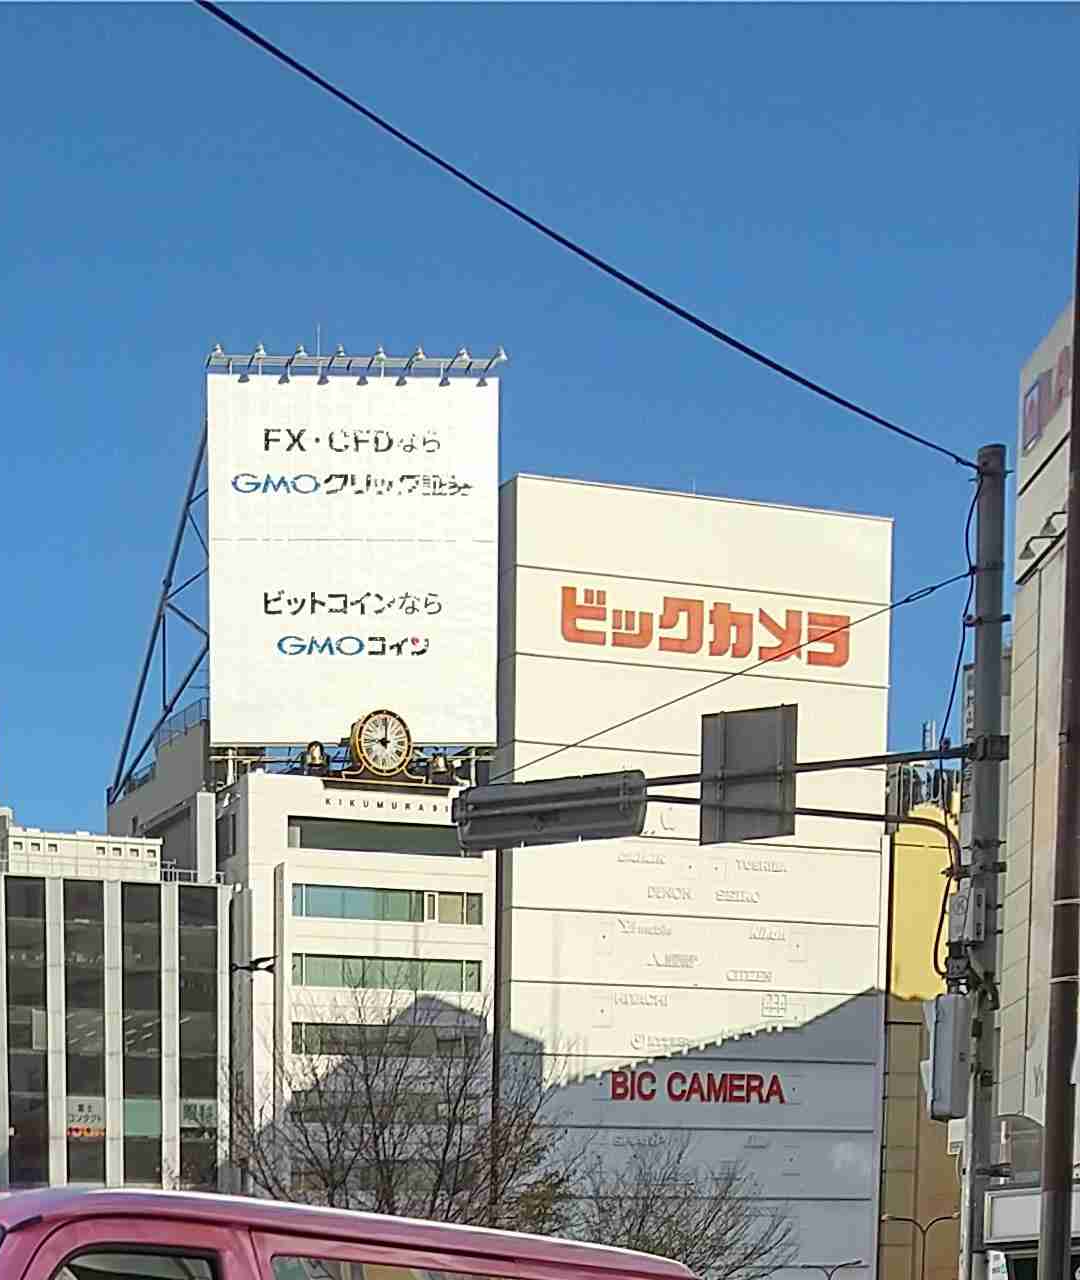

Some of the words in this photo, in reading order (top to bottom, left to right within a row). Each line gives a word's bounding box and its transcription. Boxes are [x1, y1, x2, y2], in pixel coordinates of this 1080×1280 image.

[263, 590, 443, 615] ビットコインなら
[561, 586, 851, 668] ビックカメラ
[277, 635, 430, 656] GMOコイン
[610, 1071, 657, 1101] BIC
[666, 1071, 787, 1105] CAMERA
